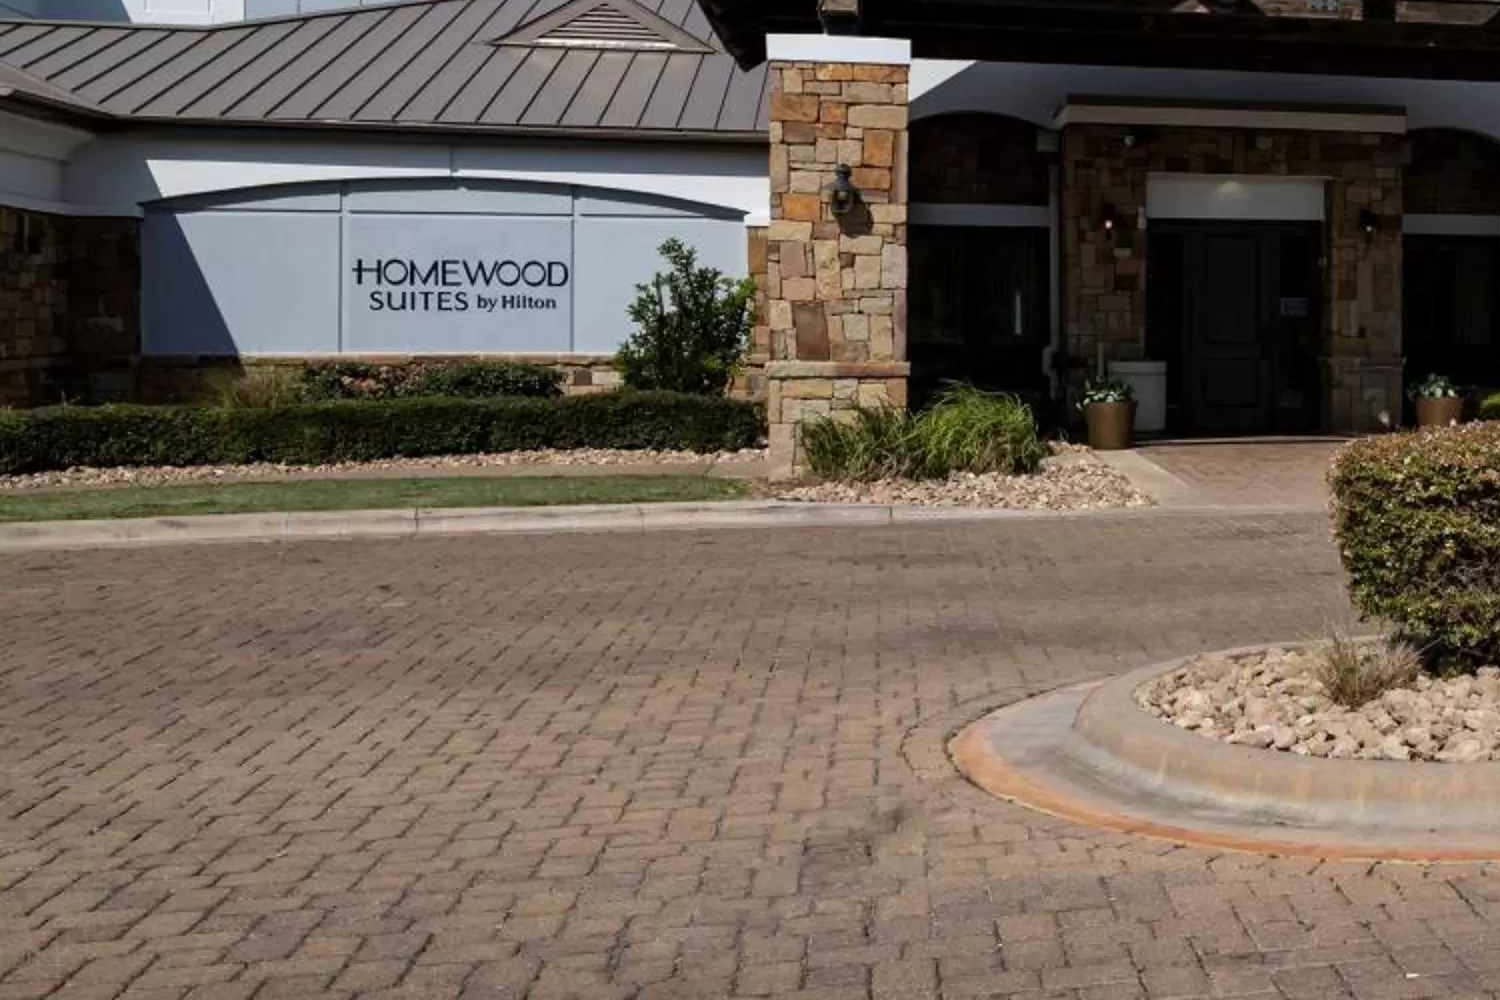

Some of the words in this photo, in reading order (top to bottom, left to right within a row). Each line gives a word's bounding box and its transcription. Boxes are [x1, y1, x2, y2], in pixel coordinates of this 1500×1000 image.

[352, 259, 569, 287] HOMEWOOD
[369, 291, 469, 311] SUITES
[476, 294, 497, 312] by
[501, 295, 557, 310] Hilton
